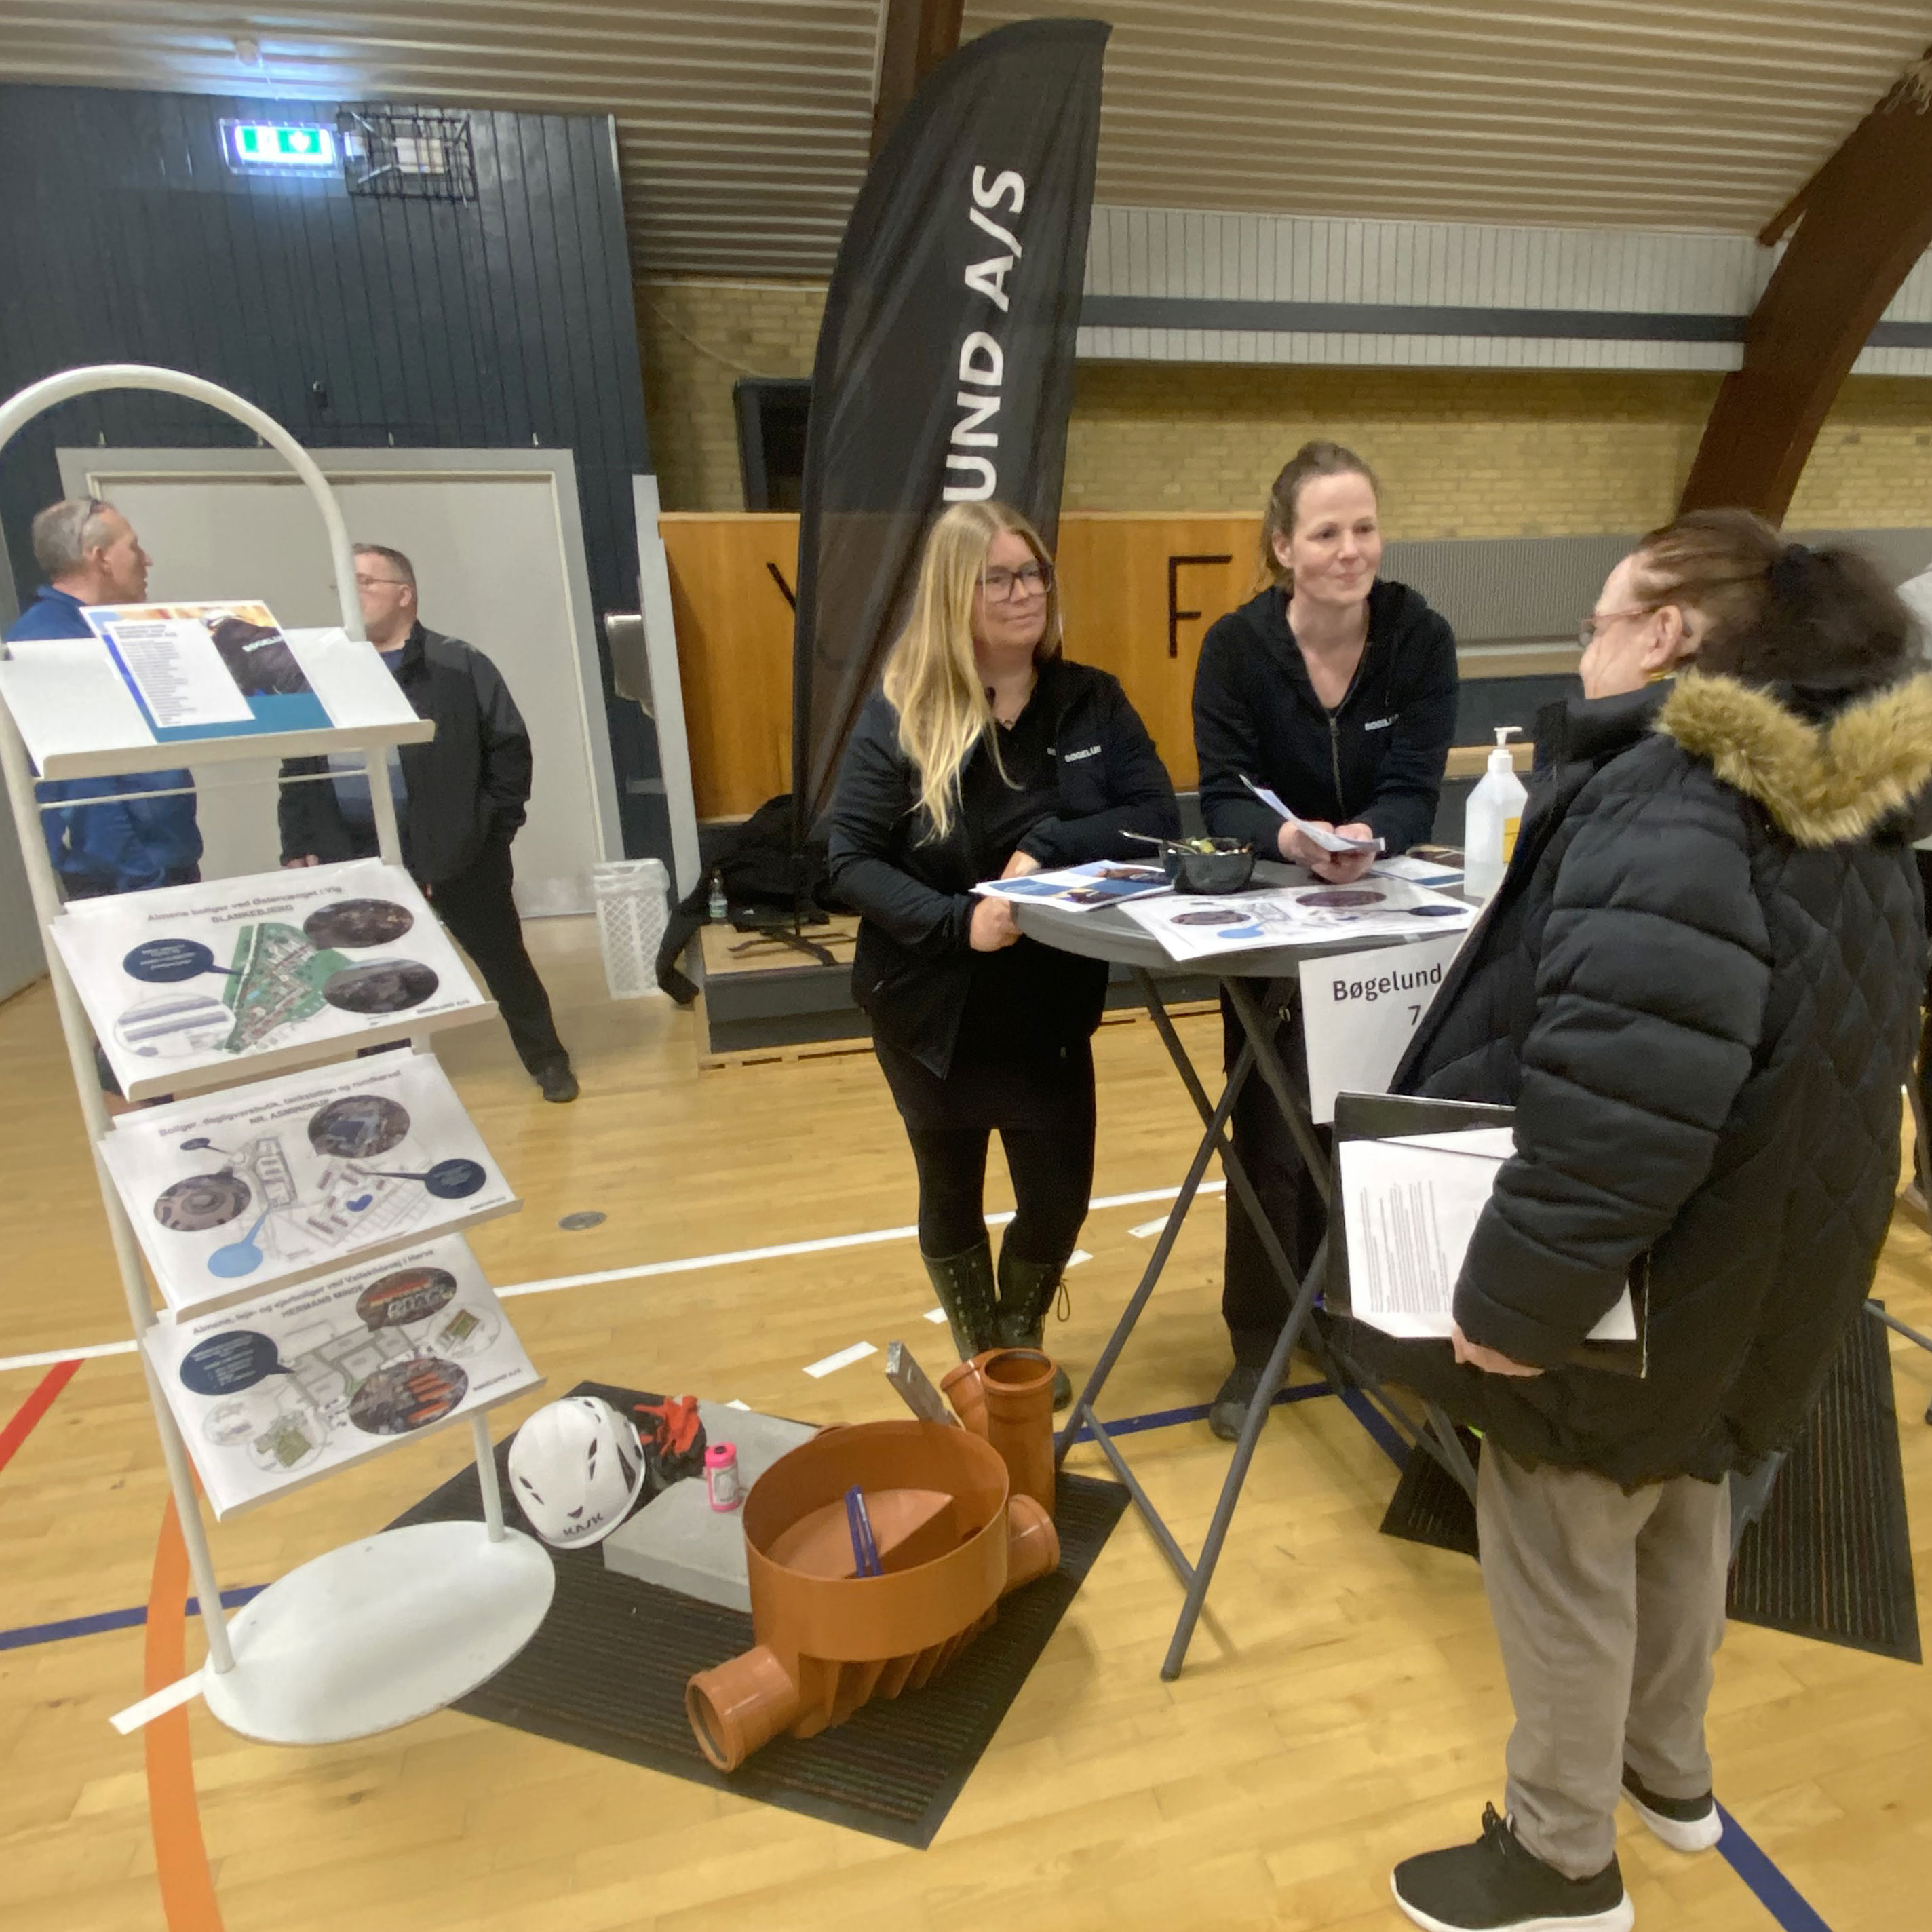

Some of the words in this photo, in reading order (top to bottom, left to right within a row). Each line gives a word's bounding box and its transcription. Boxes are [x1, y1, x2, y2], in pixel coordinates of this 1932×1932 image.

[965, 166, 1026, 313] A/S
[1168, 554, 1233, 658] F
[1333, 963, 1442, 1001] Bøgelund
[1408, 1005, 1421, 1026] 7
